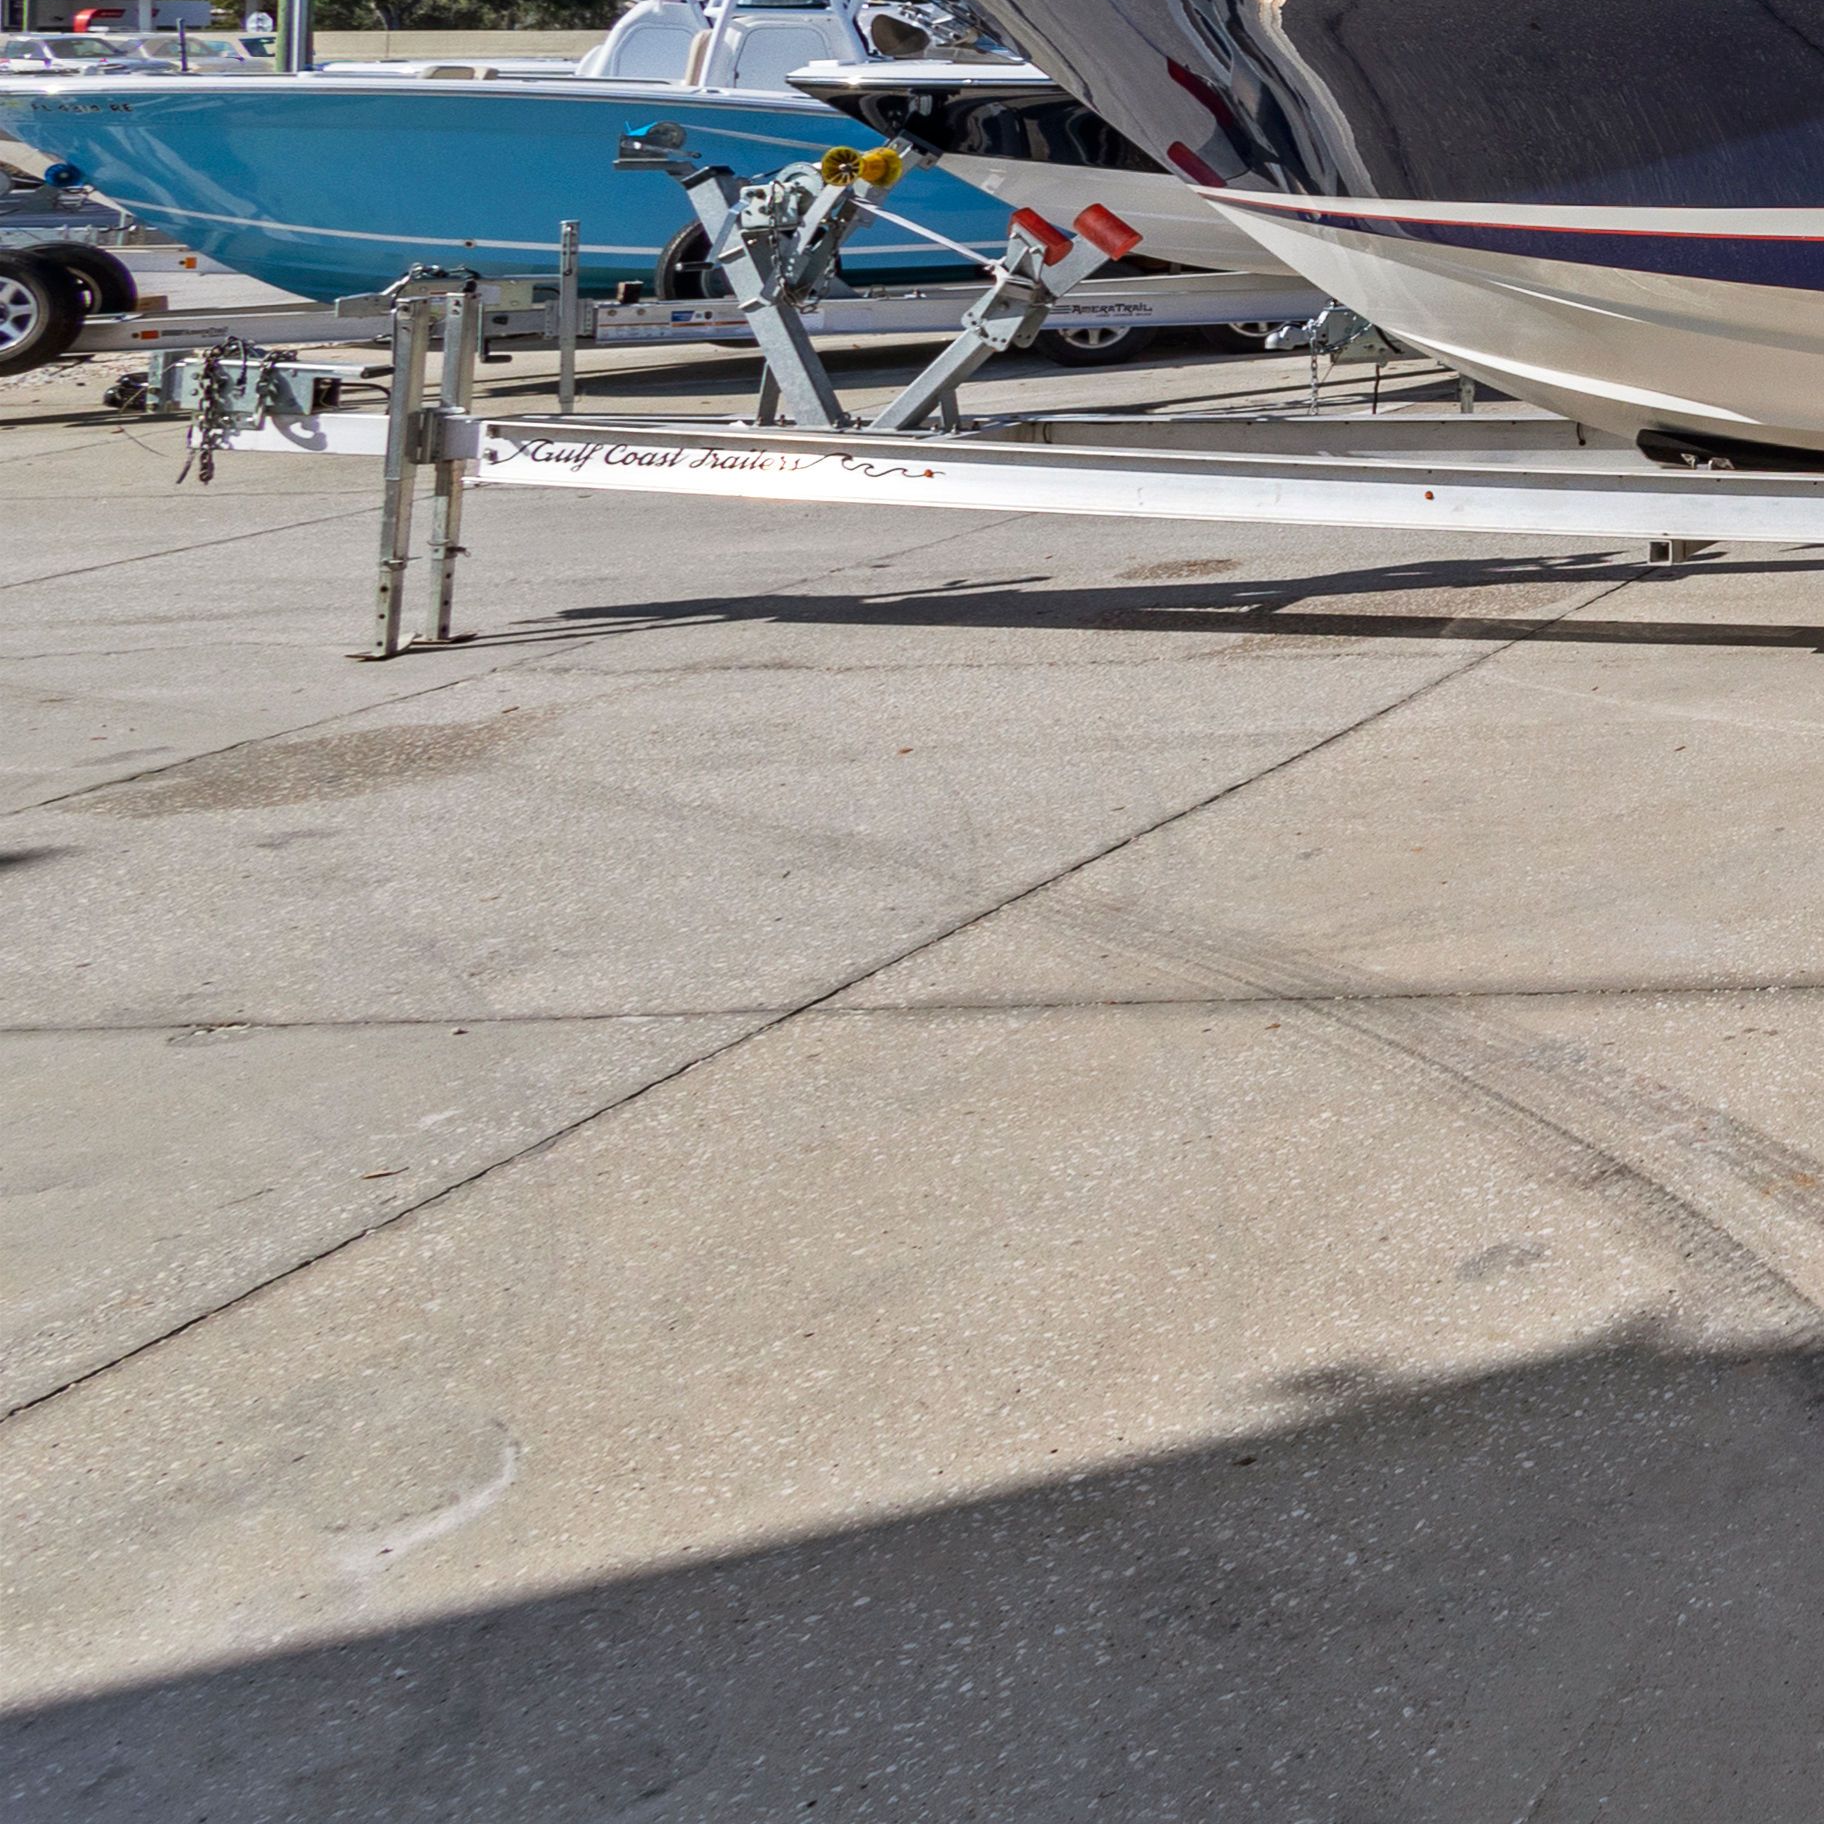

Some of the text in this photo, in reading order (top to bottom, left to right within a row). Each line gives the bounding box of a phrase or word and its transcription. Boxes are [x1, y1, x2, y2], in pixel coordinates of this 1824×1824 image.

[526, 439, 803, 472] Gulf Coast Trailers
